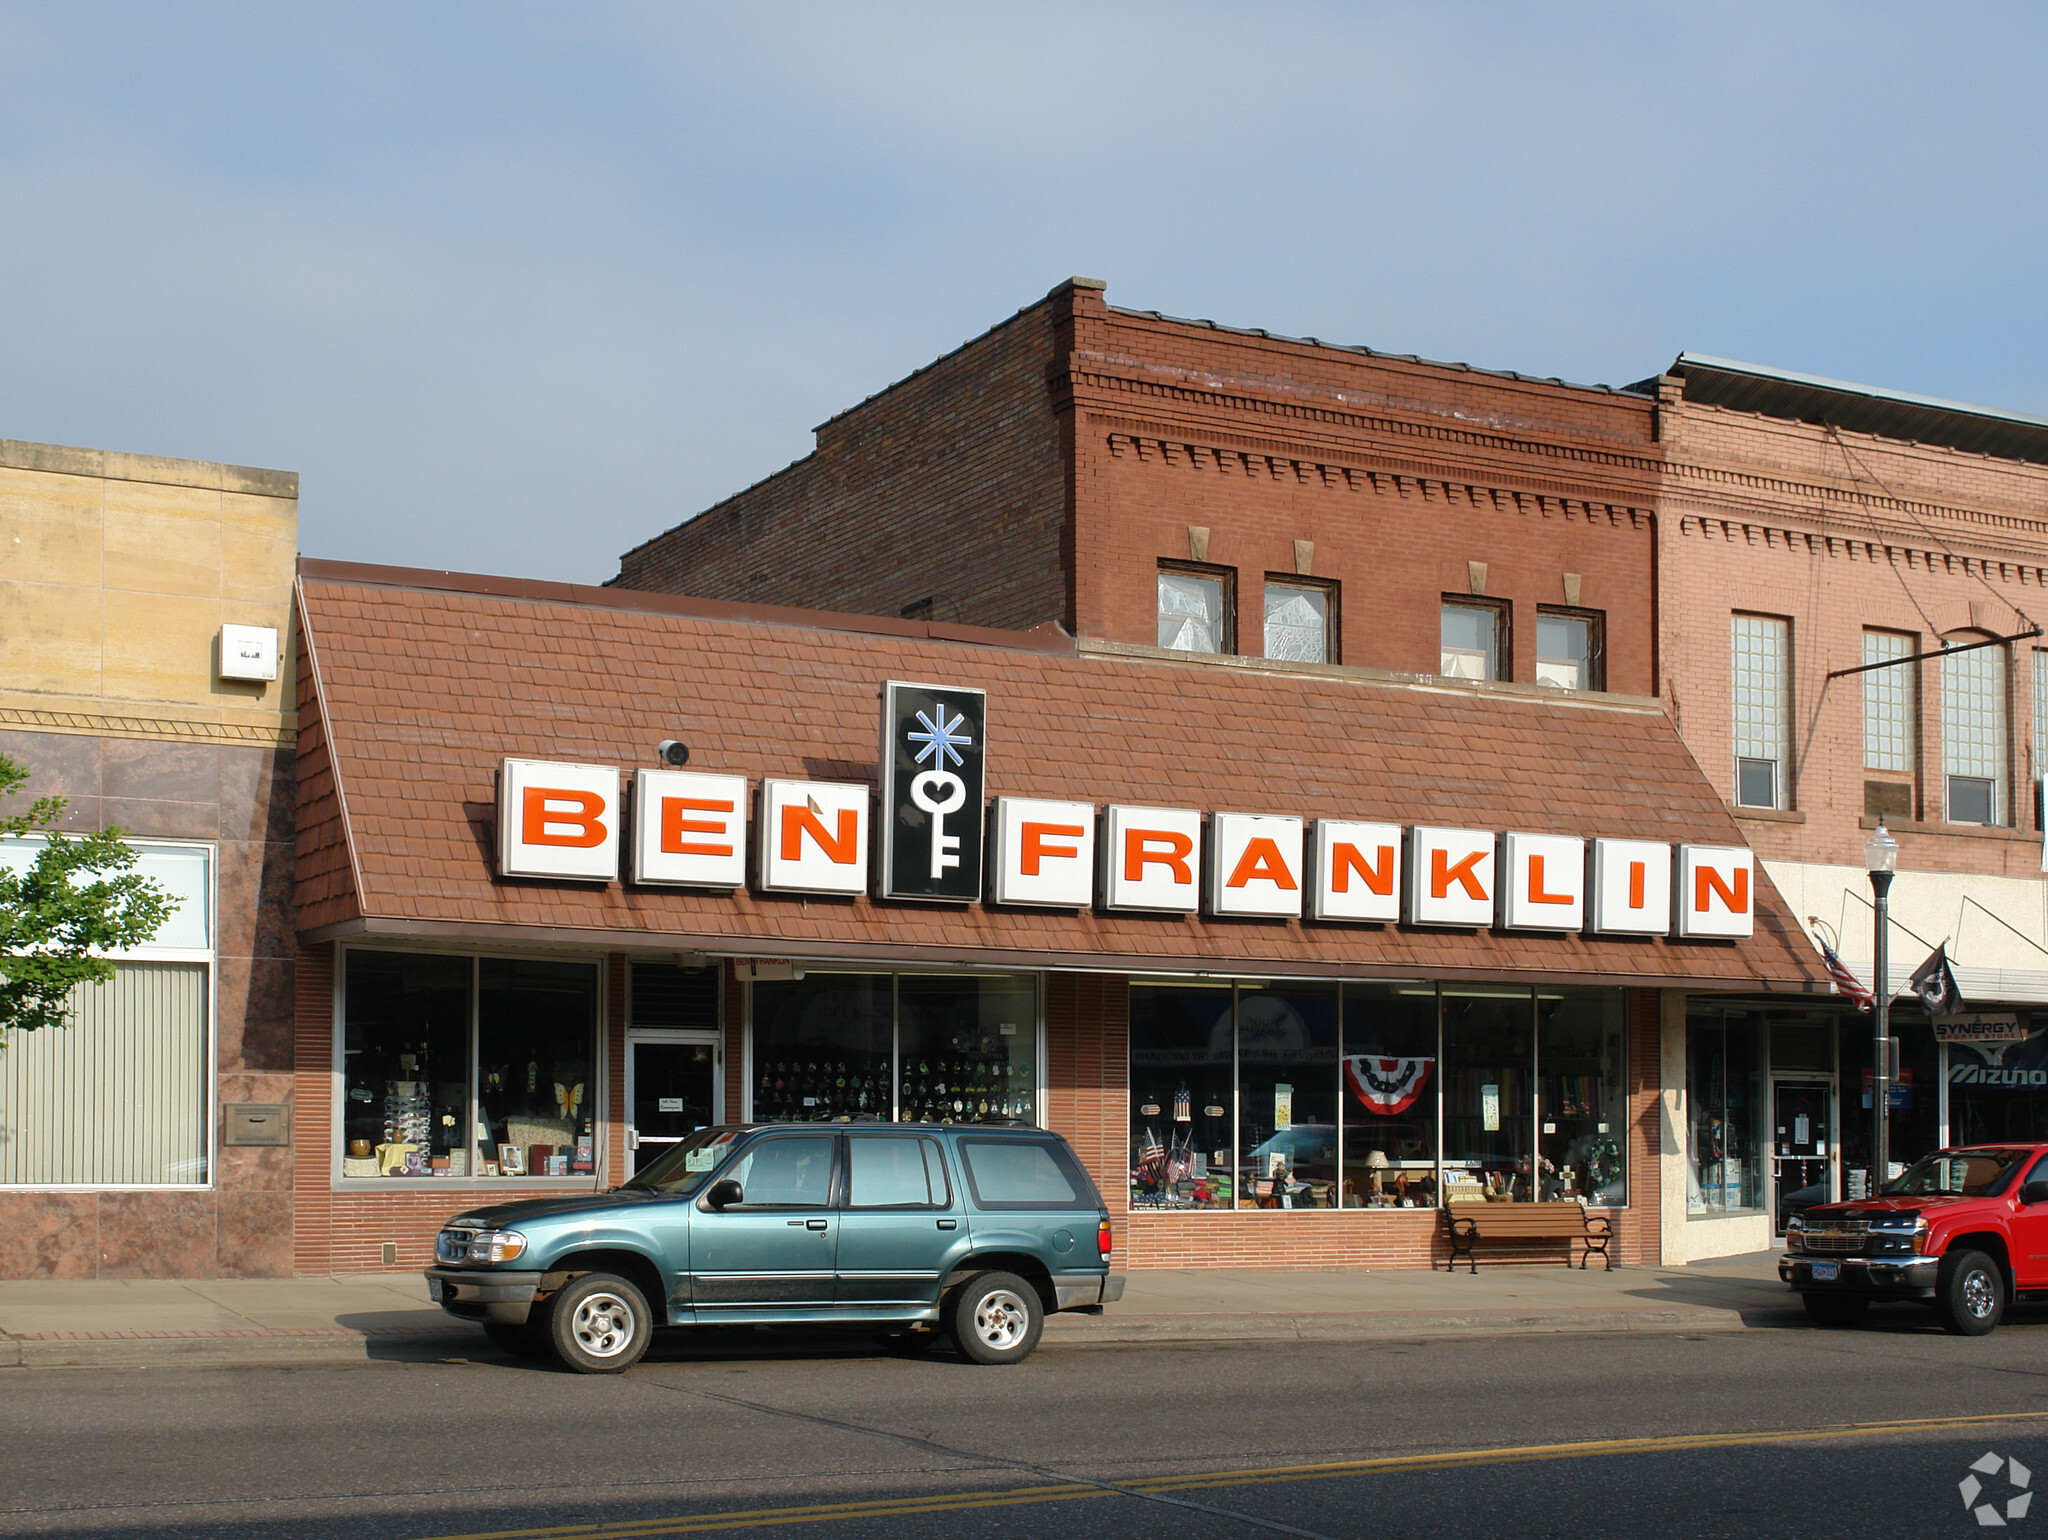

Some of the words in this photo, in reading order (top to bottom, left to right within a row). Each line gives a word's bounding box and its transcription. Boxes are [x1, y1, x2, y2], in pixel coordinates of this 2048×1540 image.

[522, 786, 857, 865] BEN
[1021, 821, 1748, 914] FRANKLIN
[1936, 1022, 2017, 1035] SYNERGY
